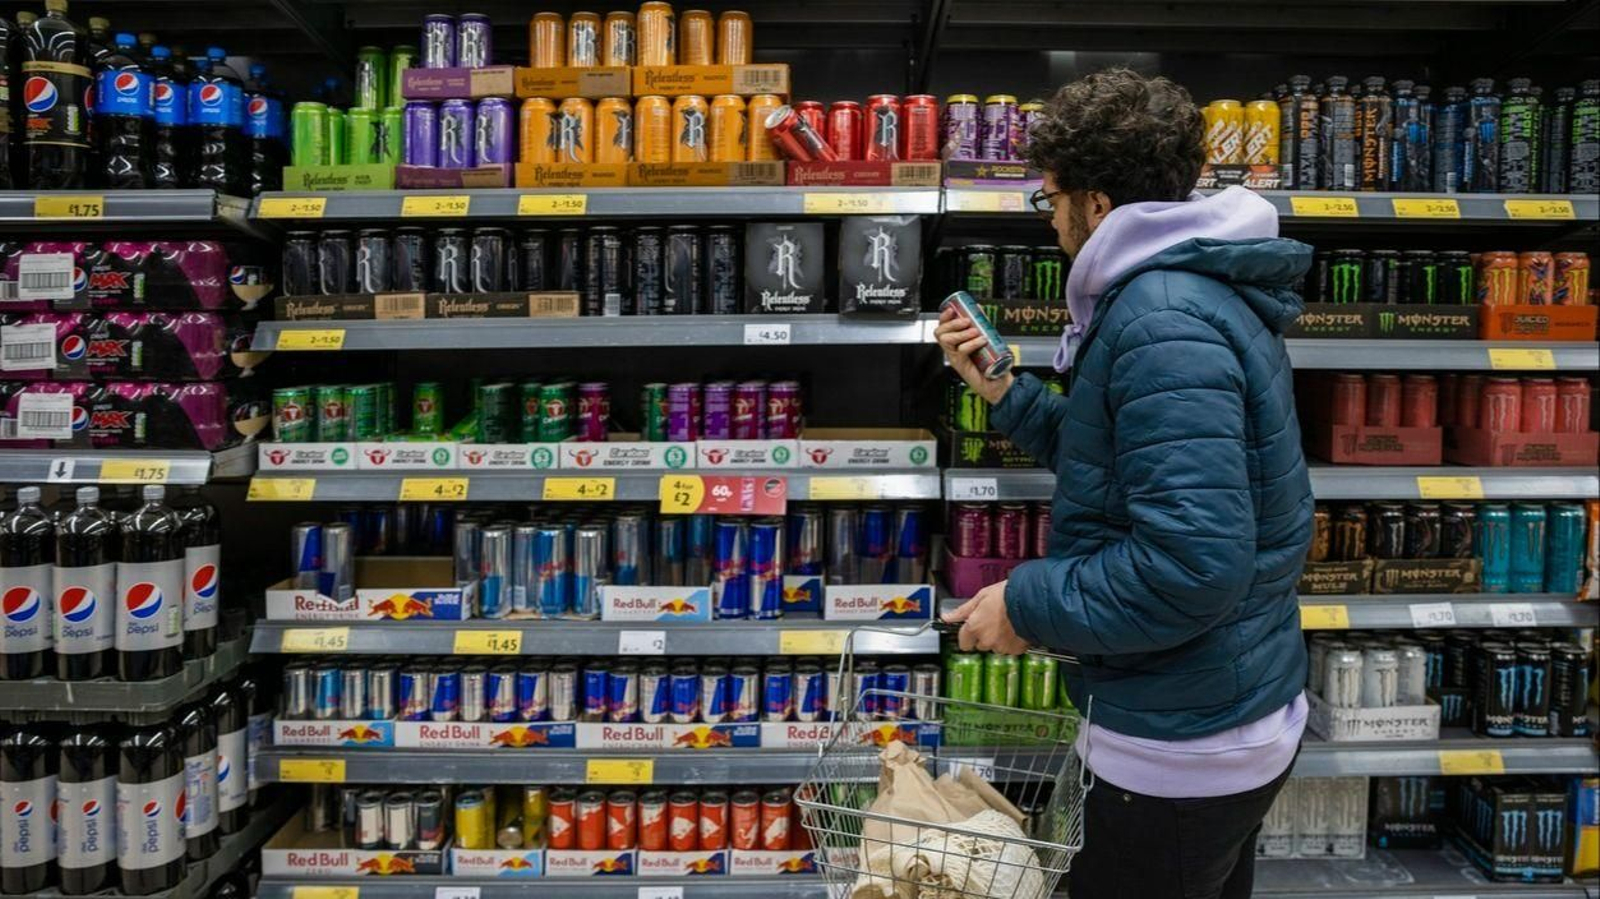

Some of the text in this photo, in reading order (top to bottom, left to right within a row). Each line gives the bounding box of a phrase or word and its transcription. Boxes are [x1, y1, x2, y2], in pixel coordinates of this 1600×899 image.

[645, 69, 695, 88] Relentless
[535, 166, 584, 186] Relentless
[638, 162, 689, 183] Relentless
[796, 166, 846, 186] Relentless
[303, 173, 347, 190] Relentless
[1242, 178, 1281, 188] ALERT
[68, 203, 99, 217] £1.75
[88, 272, 132, 289] MAX
[856, 282, 907, 304] Relentless
[438, 296, 489, 316] Relentless
[761, 289, 811, 311] Relentless
[286, 300, 335, 320] Relentless
[1004, 305, 1071, 324] MONST
[1397, 313, 1471, 326] MONSTER
[86, 339, 130, 356] MAX
[88, 411, 133, 428] MAX
[134, 467, 165, 480] £1.75
[434, 485, 443, 495] 4
[577, 484, 586, 495] 4
[673, 481, 681, 490] 4
[970, 486, 995, 496] £1.70
[674, 492, 690, 506] £2
[613, 597, 656, 609] Red Bull
[835, 596, 878, 608] Red Bull
[4, 626, 38, 638] pepsi
[62, 626, 94, 638] pepsi
[126, 622, 159, 635] pepsi
[314, 636, 344, 648] £1.45
[488, 638, 517, 651] £1.45
[652, 639, 664, 650] £2
[1363, 718, 1428, 728] MONSTER
[282, 725, 331, 737] Red Bull
[420, 725, 480, 739] Red Bull
[603, 726, 664, 741] Red Bull
[787, 725, 817, 739] Red
[84, 818, 99, 853] pepsi
[145, 819, 161, 853] pepsi
[288, 852, 348, 868] Red Bull
[457, 855, 495, 866] Red Bull
[549, 857, 587, 867] Red Bull
[642, 858, 680, 868] Red Bull
[735, 857, 772, 867] Red Bull
